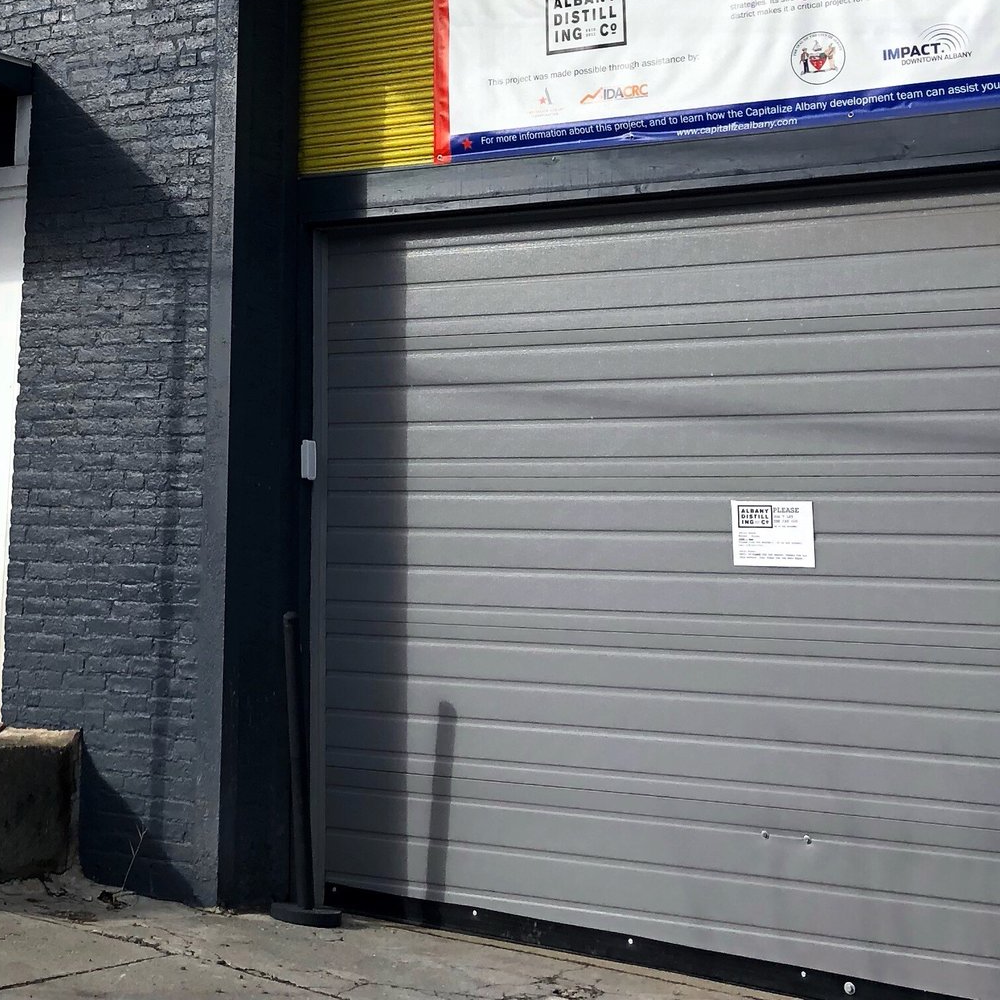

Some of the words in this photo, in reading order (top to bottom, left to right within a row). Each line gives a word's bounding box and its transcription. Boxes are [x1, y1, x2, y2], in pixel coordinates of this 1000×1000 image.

[553, 6, 617, 26] DISTILL
[757, 7, 782, 16] makes
[797, 0, 822, 10] critical
[554, 27, 582, 43] ING
[901, 55, 943, 66] DOWNTOWN
[944, 51, 972, 60] ALBANY
[488, 77, 503, 86] This
[505, 73, 531, 86] project
[550, 68, 571, 78] made
[573, 64, 606, 77] possible
[609, 59, 639, 71] through
[641, 56, 685, 67] assistance
[481, 135, 494, 144] For
[496, 134, 517, 143] more
[519, 127, 566, 140] information
[569, 123, 594, 135] about
[595, 122, 612, 132] this
[614, 118, 647, 133] project,
[649, 116, 666, 126] and
[668, 115, 678, 124] to
[680, 113, 704, 123] learn
[706, 111, 725, 120] how
[727, 108, 743, 118] the
[745, 103, 792, 117] Capitalize
[795, 100, 827, 111] Albany
[830, 91, 894, 107] development
[896, 90, 923, 100] team
[926, 87, 945, 96] can
[948, 83, 979, 94] assist
[676, 118, 798, 136] www.capitalizealbany.com
